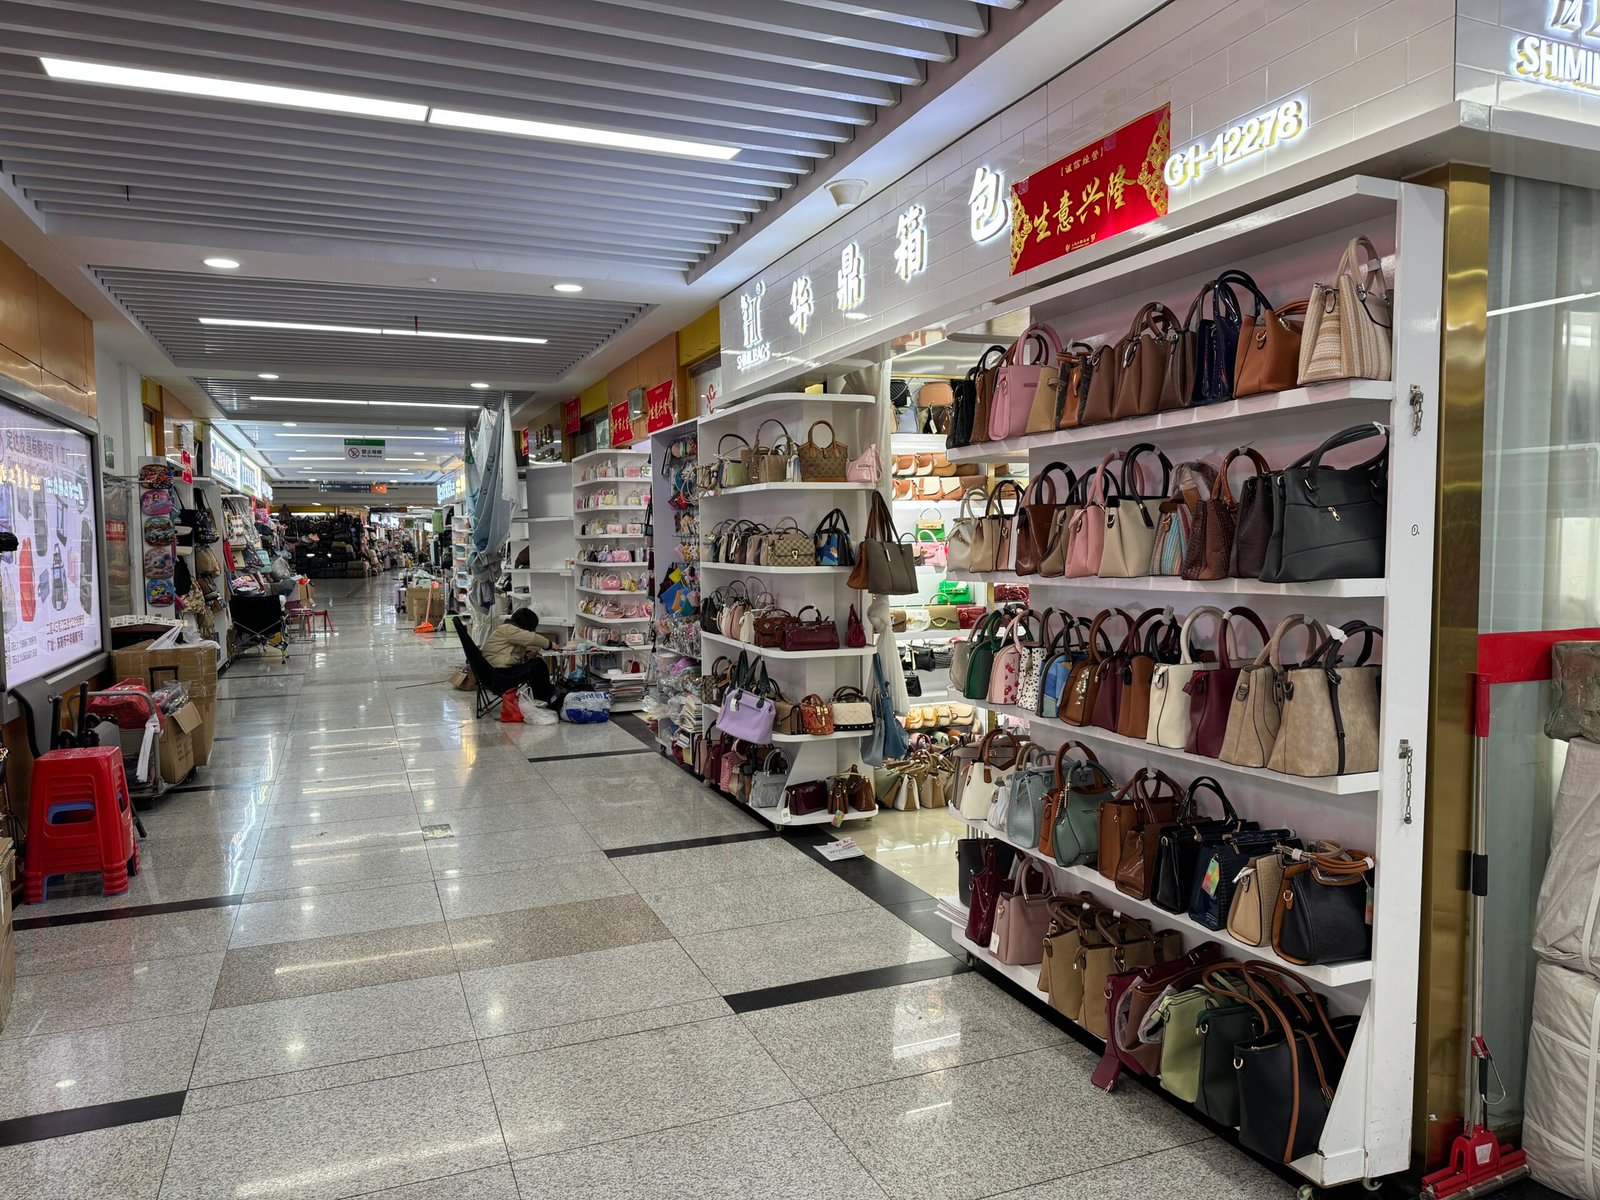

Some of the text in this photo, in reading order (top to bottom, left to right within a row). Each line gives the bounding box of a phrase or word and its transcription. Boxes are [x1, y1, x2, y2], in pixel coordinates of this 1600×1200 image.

[1164, 100, 1305, 187] G1-12278
[1032, 164, 1137, 242] 生意兴隆
[788, 166, 1010, 334] 华鼎箱包
